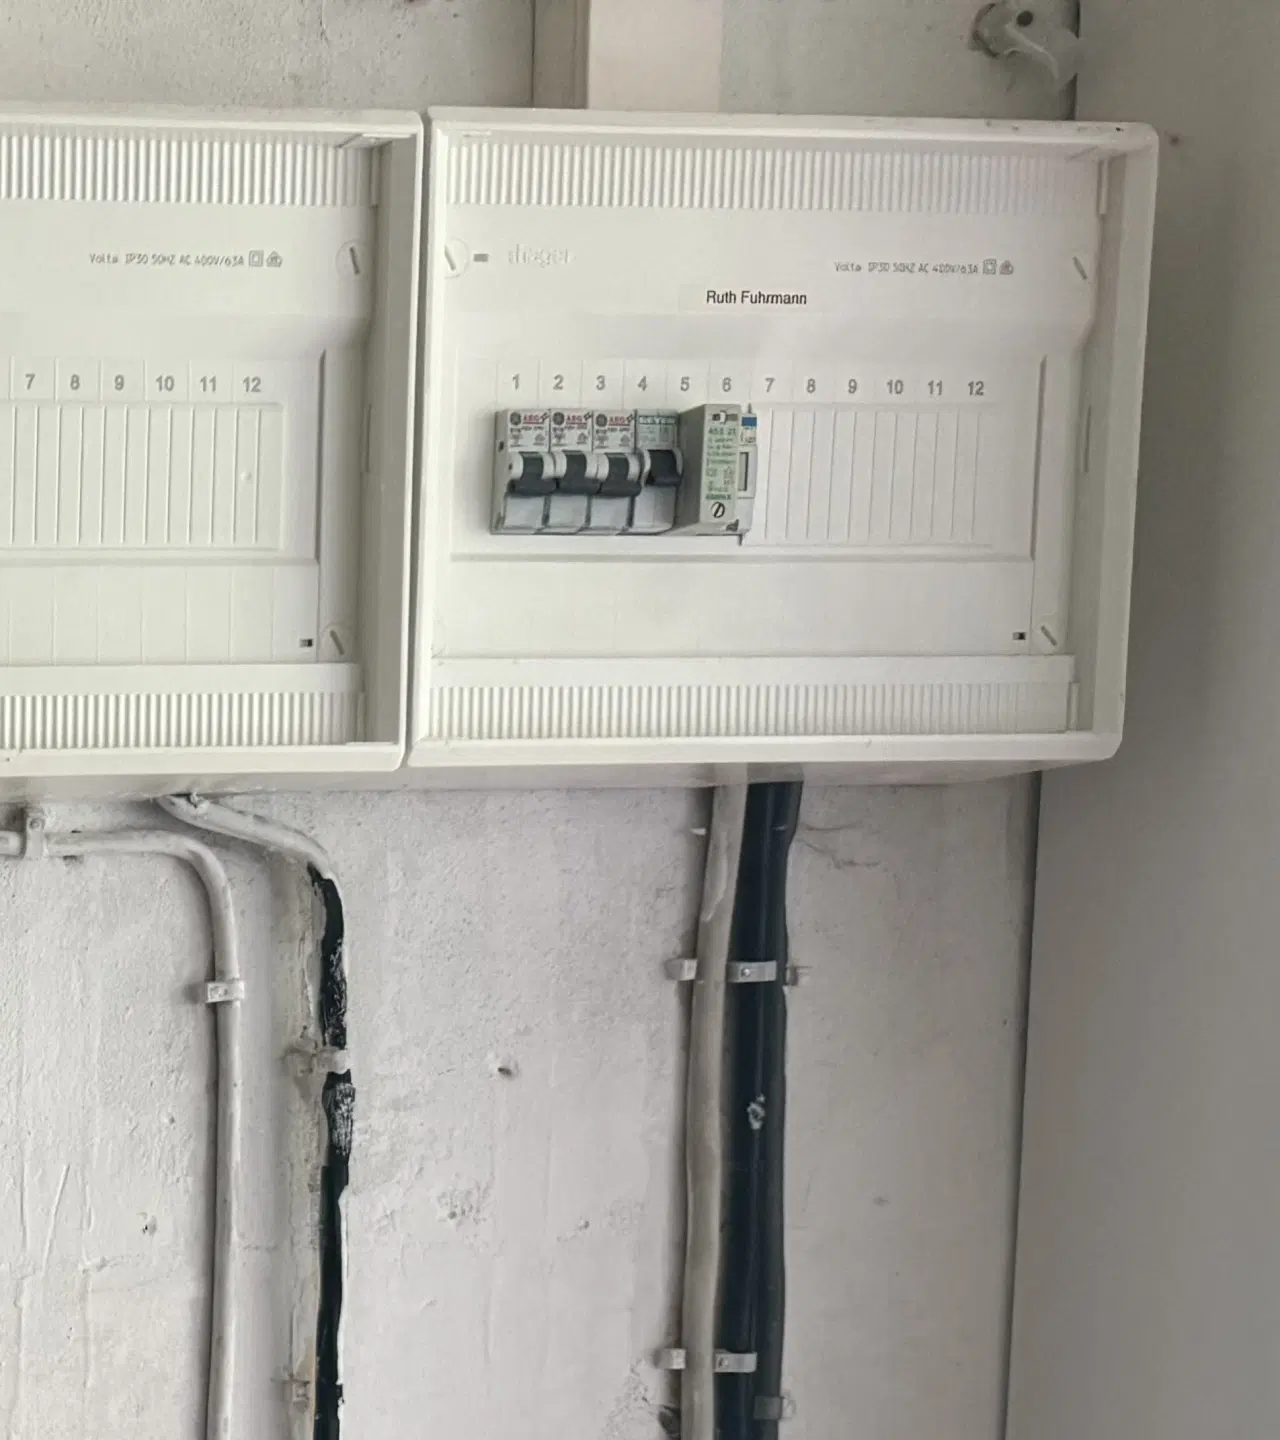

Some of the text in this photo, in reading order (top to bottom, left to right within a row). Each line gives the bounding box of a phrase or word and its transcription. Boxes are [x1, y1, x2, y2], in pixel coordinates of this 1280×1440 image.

[706, 290, 807, 304] Ruth Fuhrmann
[25, 373, 35, 389] 7
[70, 374, 80, 390] 8
[114, 374, 125, 391] 9
[155, 375, 175, 392] 10
[200, 375, 217, 392] 11
[243, 376, 261, 392] 12
[512, 374, 984, 396] 1 2 3 4 5 6 7 8 9 10 11 12
